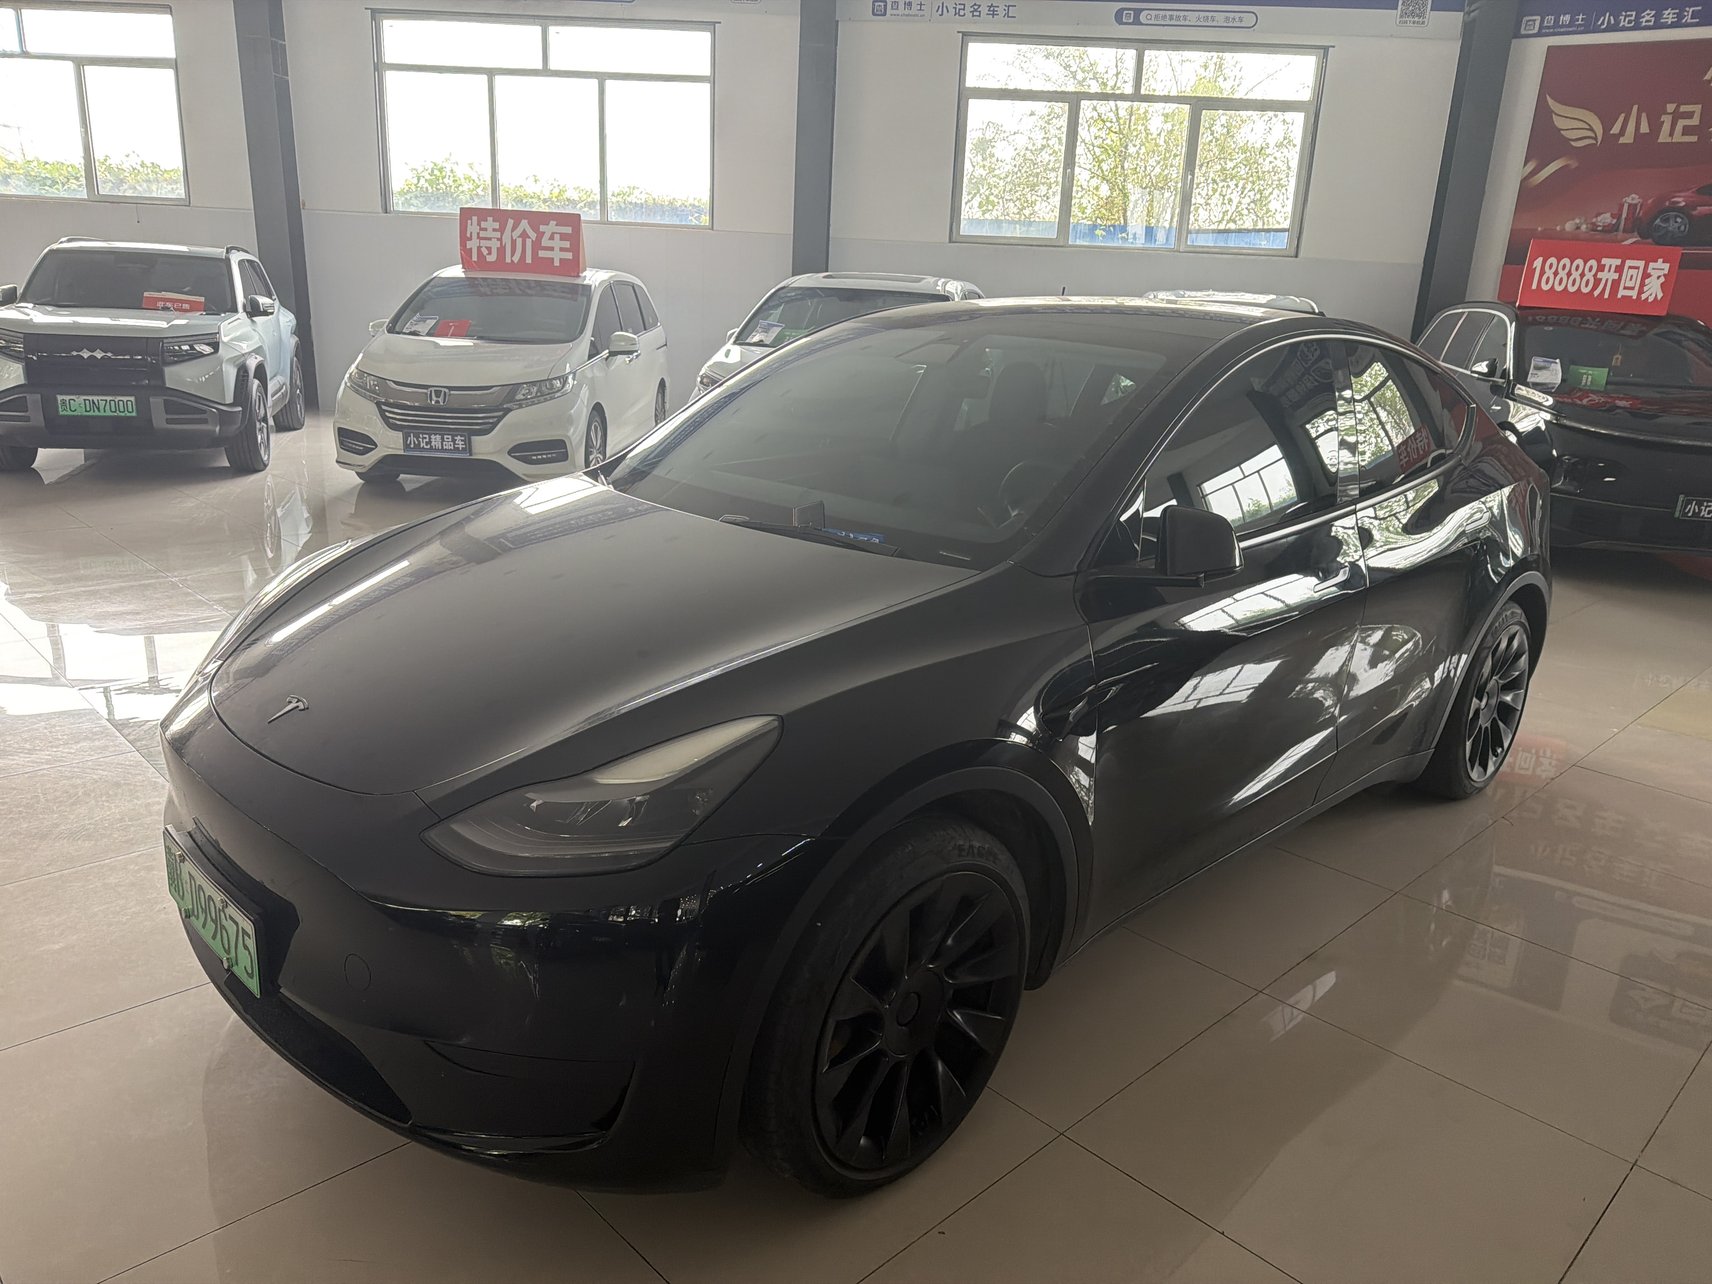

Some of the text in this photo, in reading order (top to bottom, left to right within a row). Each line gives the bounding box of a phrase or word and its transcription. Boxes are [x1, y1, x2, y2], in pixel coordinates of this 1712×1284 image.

[935, 2, 1017, 19] 小记名车汇
[1597, 6, 1702, 29] 小记名车汇
[1609, 102, 1712, 144] 小记
[466, 215, 573, 267] 特价车
[1530, 256, 1670, 303] 18888开回家
[406, 432, 466, 451] 小记精品车
